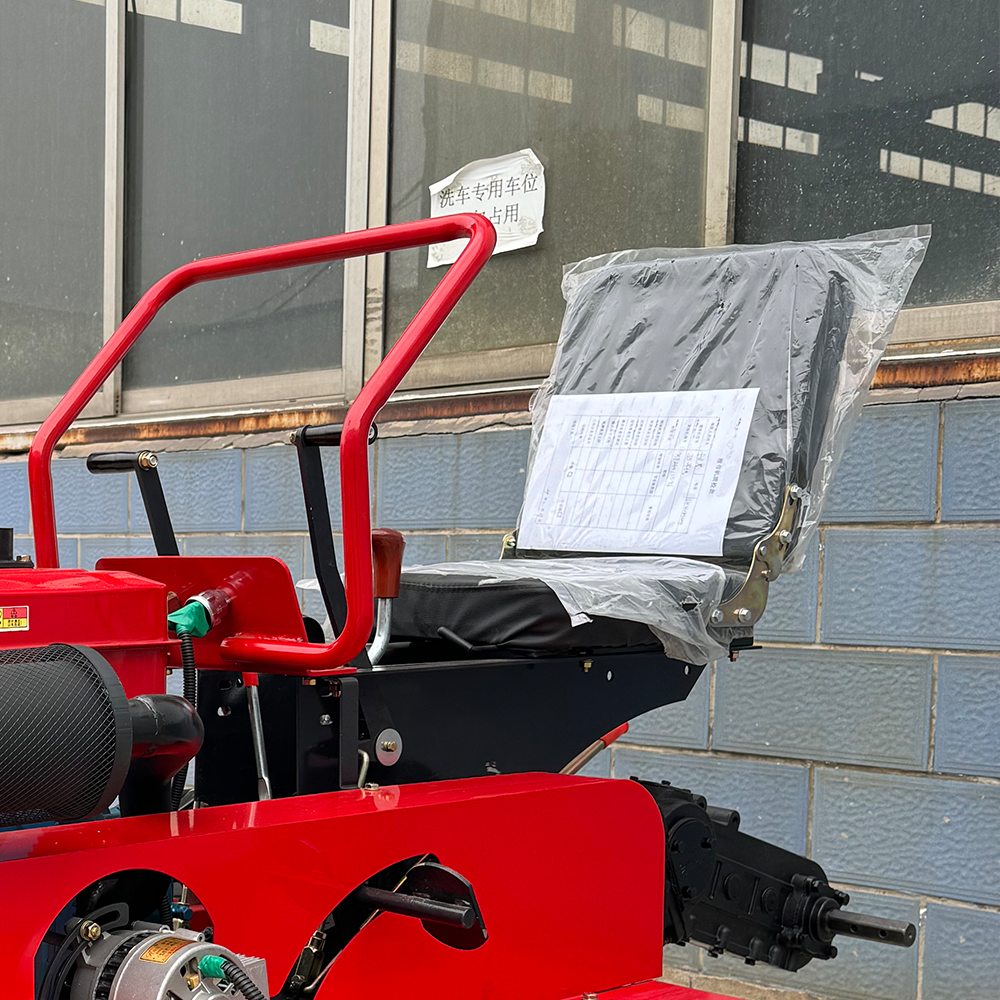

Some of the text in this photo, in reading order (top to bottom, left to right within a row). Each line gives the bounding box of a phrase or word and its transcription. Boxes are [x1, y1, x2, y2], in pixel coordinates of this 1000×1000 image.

[439, 173, 538, 208] 洗车专用车位
